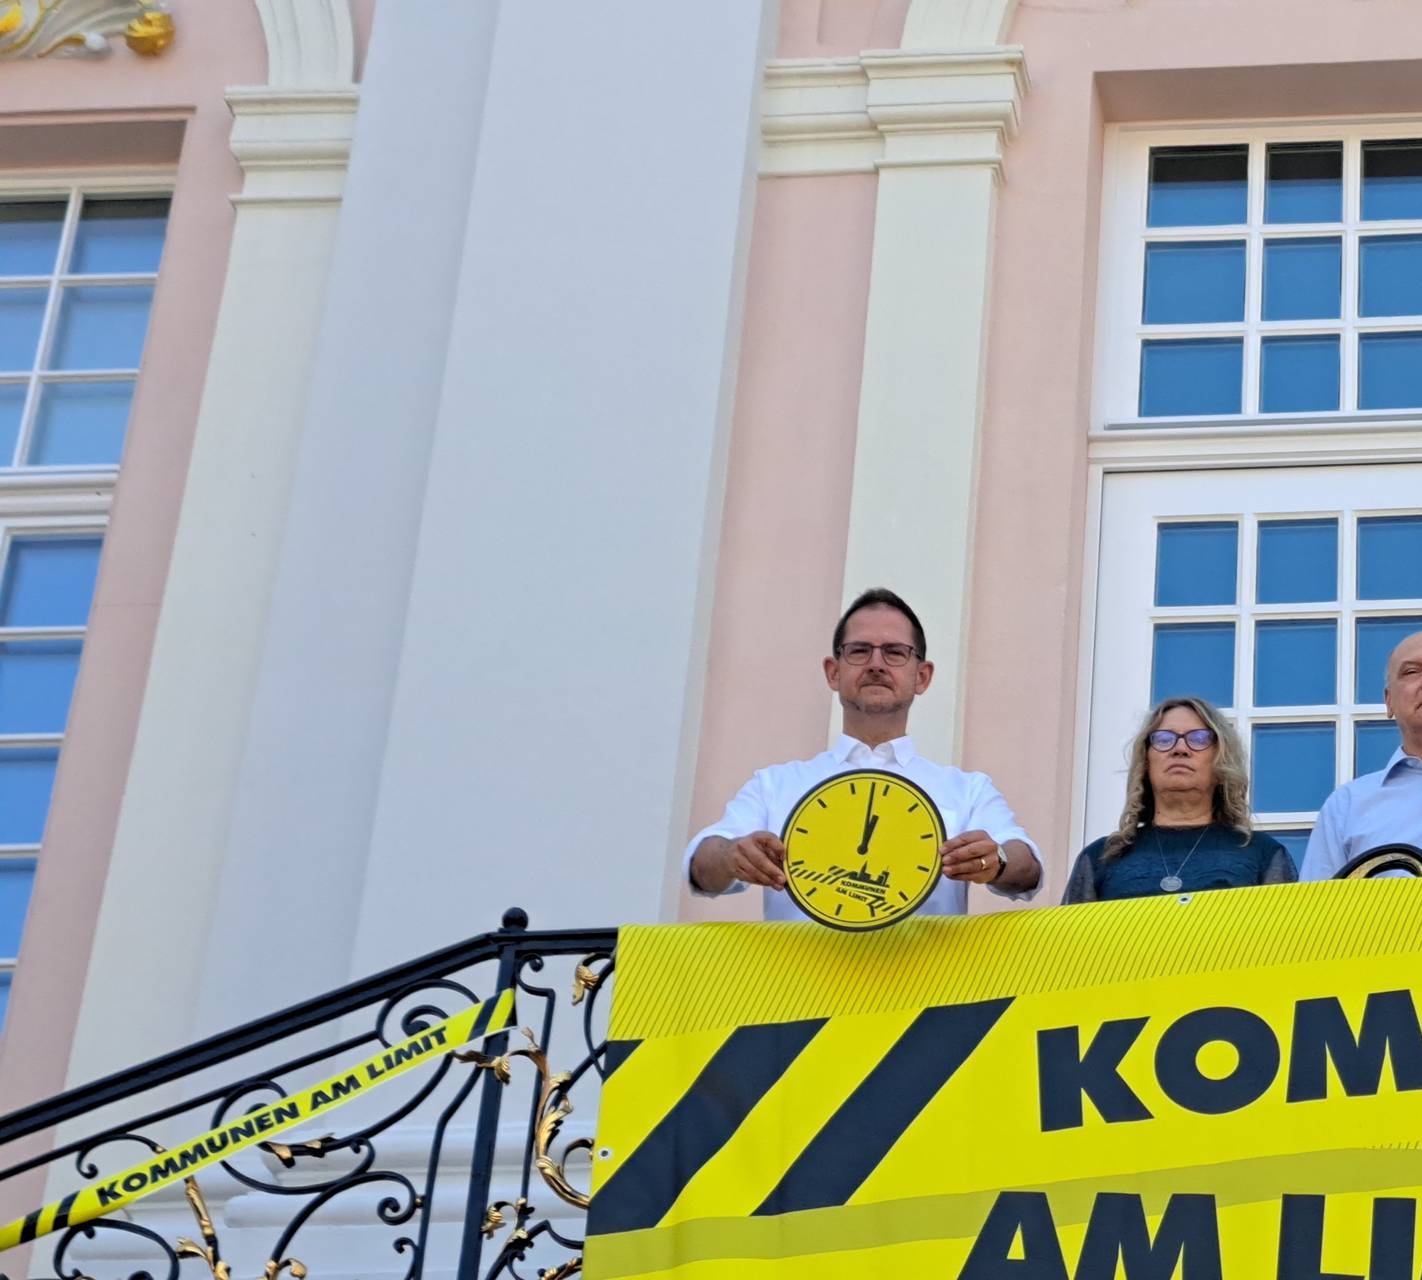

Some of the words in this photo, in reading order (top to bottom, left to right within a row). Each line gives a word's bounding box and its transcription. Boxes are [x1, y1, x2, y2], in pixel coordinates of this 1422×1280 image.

[96, 1102, 301, 1207] KOMMUNEN
[309, 1074, 362, 1111] AM
[366, 1026, 447, 1080] LIMIT
[956, 1190, 1223, 1280] AM
